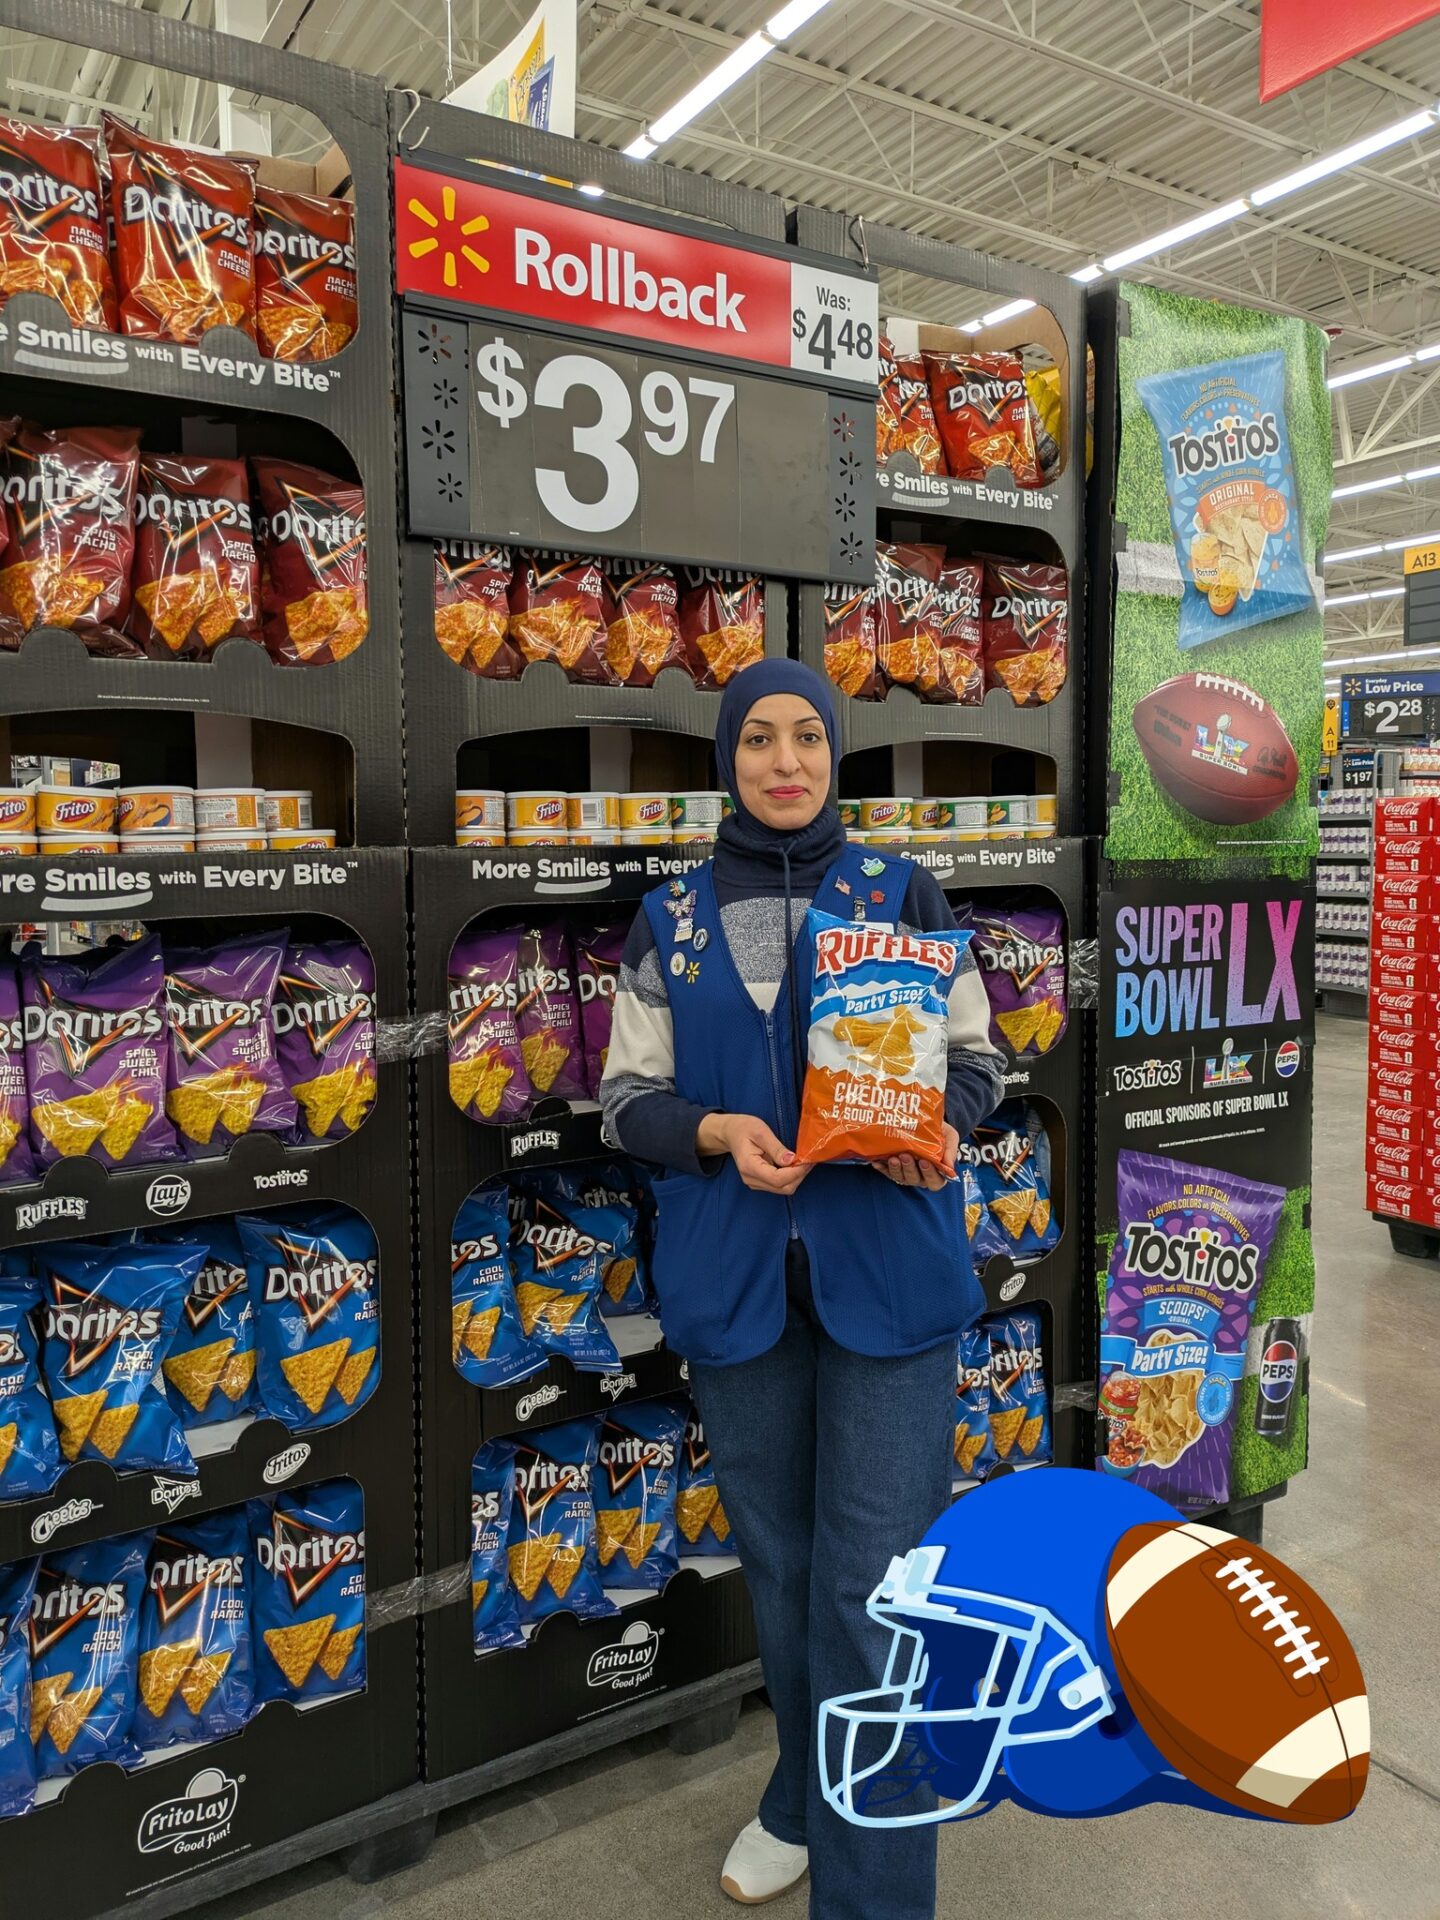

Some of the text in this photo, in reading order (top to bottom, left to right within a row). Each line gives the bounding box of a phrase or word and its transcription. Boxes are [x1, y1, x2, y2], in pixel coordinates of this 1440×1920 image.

[0, 171, 99, 220] oritos
[125, 185, 250, 246] Doritos
[70, 225, 103, 243] NACHO
[218, 256, 250, 278] CHEESE
[220, 249, 250, 268] NACHO
[513, 227, 747, 333] Rollback
[325, 284, 356, 299] CHEES
[816, 285, 851, 312] Was:
[18, 320, 127, 360] Smiles
[135, 346, 174, 364] with
[181, 347, 266, 385] Every
[894, 471, 949, 496] Smiles
[953, 485, 972, 497] with
[976, 483, 1019, 510] Every
[1209, 483, 1255, 506] ORIGINAL
[73, 534, 117, 552] NACHO
[1412, 552, 1436, 569] A13
[577, 583, 602, 593] NACH
[1365, 681, 1424, 694] Low Price
[1326, 727, 1335, 736] A
[1327, 740, 1334, 748] 11
[1199, 752, 1222, 767] SUPER
[0, 800, 27, 820] ritos
[55, 800, 96, 822] Fritos
[870, 805, 897, 821] Fritos
[957, 853, 977, 864] with
[980, 849, 1023, 867] Every
[44, 867, 152, 892] Smiles
[158, 871, 198, 885] with
[203, 865, 286, 890] Every
[472, 860, 531, 879] More
[537, 859, 610, 878] Smiles
[616, 862, 642, 873] with
[1115, 904, 1224, 967] SUPER
[816, 928, 957, 978] RUFFLES
[1225, 900, 1302, 1027] LX
[547, 1003, 570, 1012] SPICY
[846, 992, 885, 1014] Party
[1115, 967, 1220, 1038] BOWL
[24, 1005, 162, 1042] Doritos
[543, 1011, 571, 1020] SWEET
[551, 1019, 572, 1027] CHILI
[119, 1057, 159, 1070] SWEET
[124, 1048, 157, 1061] SPICY
[1277, 1054, 1299, 1064] PEPSI
[834, 1082, 922, 1116] CHEDDAR
[842, 1105, 873, 1123] SOUR
[877, 1110, 919, 1132] CREAM
[1125, 1091, 1289, 1130] OFFICIAL SPONSORS OF SUPER BOWL LX
[511, 1131, 560, 1157] RUFFLES
[1183, 1184, 1230, 1205] NO ARTIFICIAL
[16, 1198, 88, 1231] RUFFLES
[1178, 1199, 1202, 1209] COLORS
[1210, 1202, 1250, 1242] PRESERVATIVES
[473, 1273, 504, 1286] RANCH
[479, 1265, 503, 1276] COOL
[1002, 1275, 1025, 1294] Fritos
[1143, 1284, 1164, 1296] STARTS
[1158, 1302, 1207, 1321] SCOOPS!
[1131, 1344, 1209, 1373] Party Size!
[1263, 1363, 1296, 1380] PEPSI
[600, 1374, 635, 1393] Doritos
[516, 1385, 560, 1421] Cheetos
[266, 1447, 309, 1474] Fritos
[514, 1464, 590, 1490] oritos
[152, 1480, 200, 1502] Doritos
[31, 1500, 93, 1543] Cheetos
[150, 1555, 244, 1589] oritos
[32, 1582, 126, 1620] oritos
[220, 1599, 244, 1610] COOL
[210, 1609, 244, 1620] RANCH
[92, 1630, 121, 1641] COOL
[81, 1640, 120, 1653] RANCH
[611, 1666, 654, 1690] Good fun!
[174, 1823, 232, 1855] Good fun!
